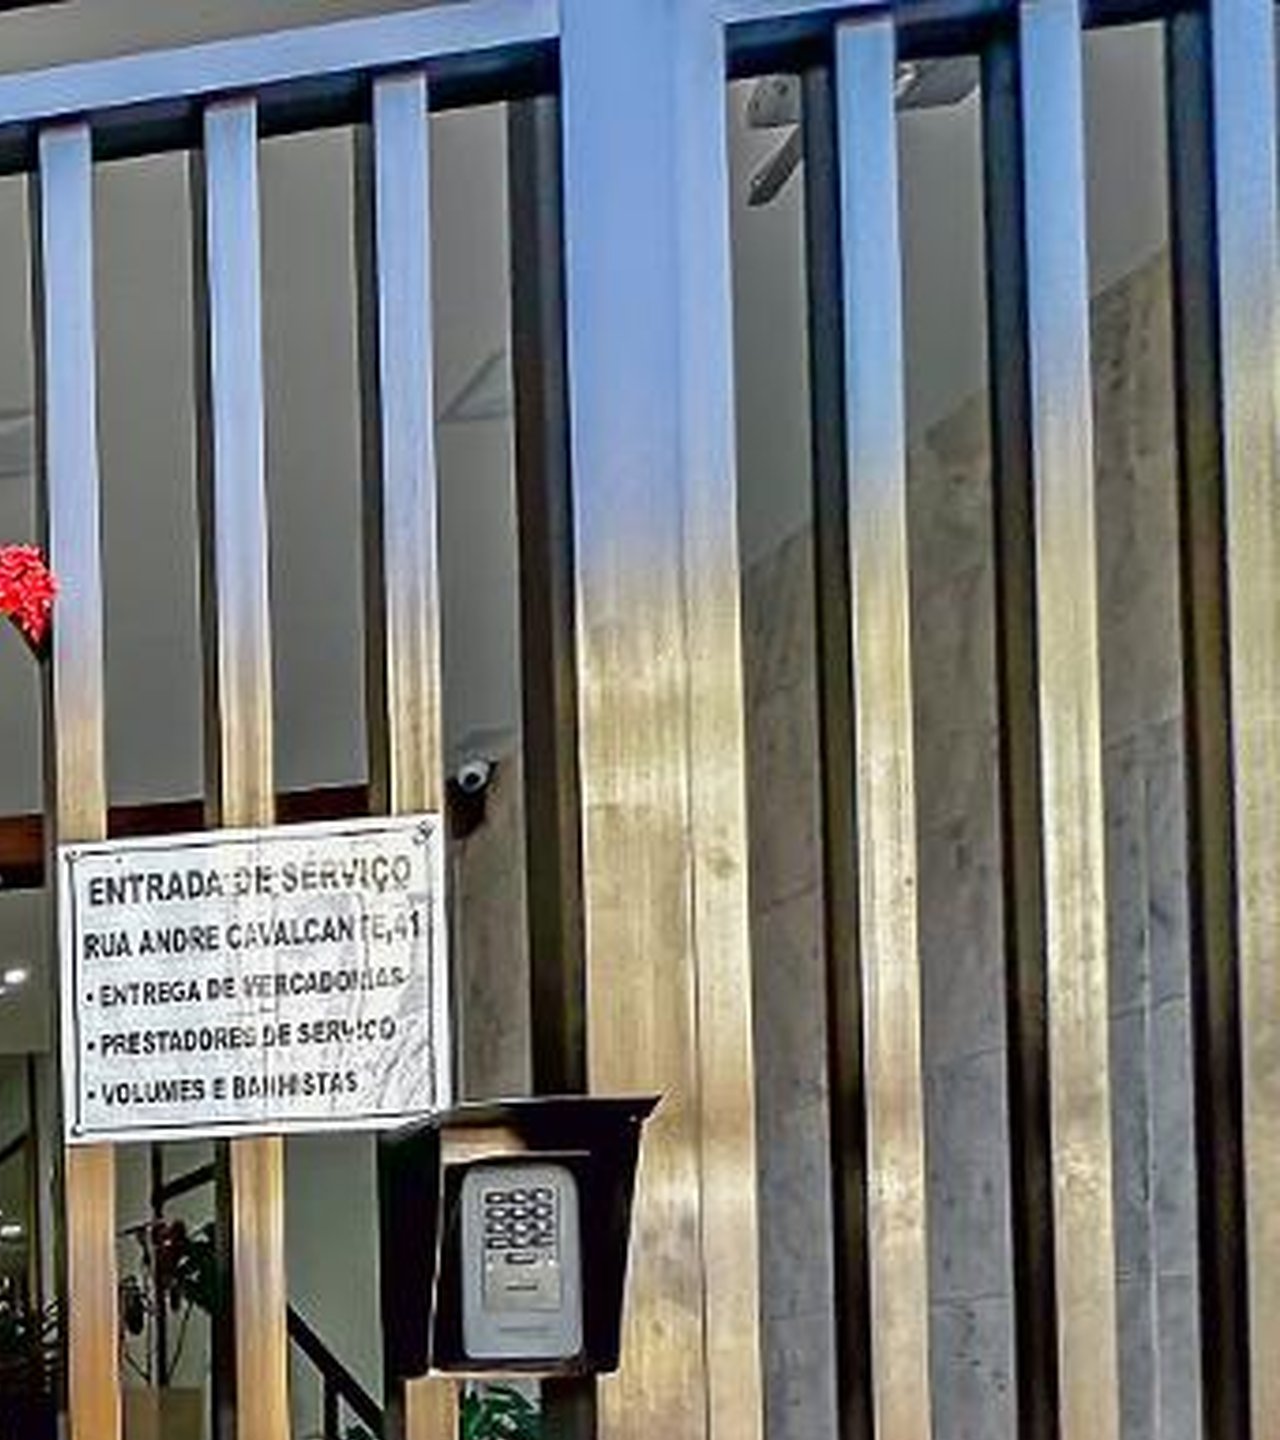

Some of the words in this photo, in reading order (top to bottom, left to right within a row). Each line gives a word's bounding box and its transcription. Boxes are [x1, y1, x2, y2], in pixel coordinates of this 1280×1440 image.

[89, 869, 224, 905] ENTRADA
[233, 865, 274, 895] DE
[84, 929, 132, 960] RUA
[139, 923, 219, 953] ANDRE
[100, 980, 201, 1008] ENTREGA
[206, 977, 236, 1000] DE
[100, 1026, 257, 1057] PRESTADORES
[262, 1023, 291, 1048] DE
[101, 1078, 205, 1105] VOLUMES
[213, 1077, 227, 1100] E
